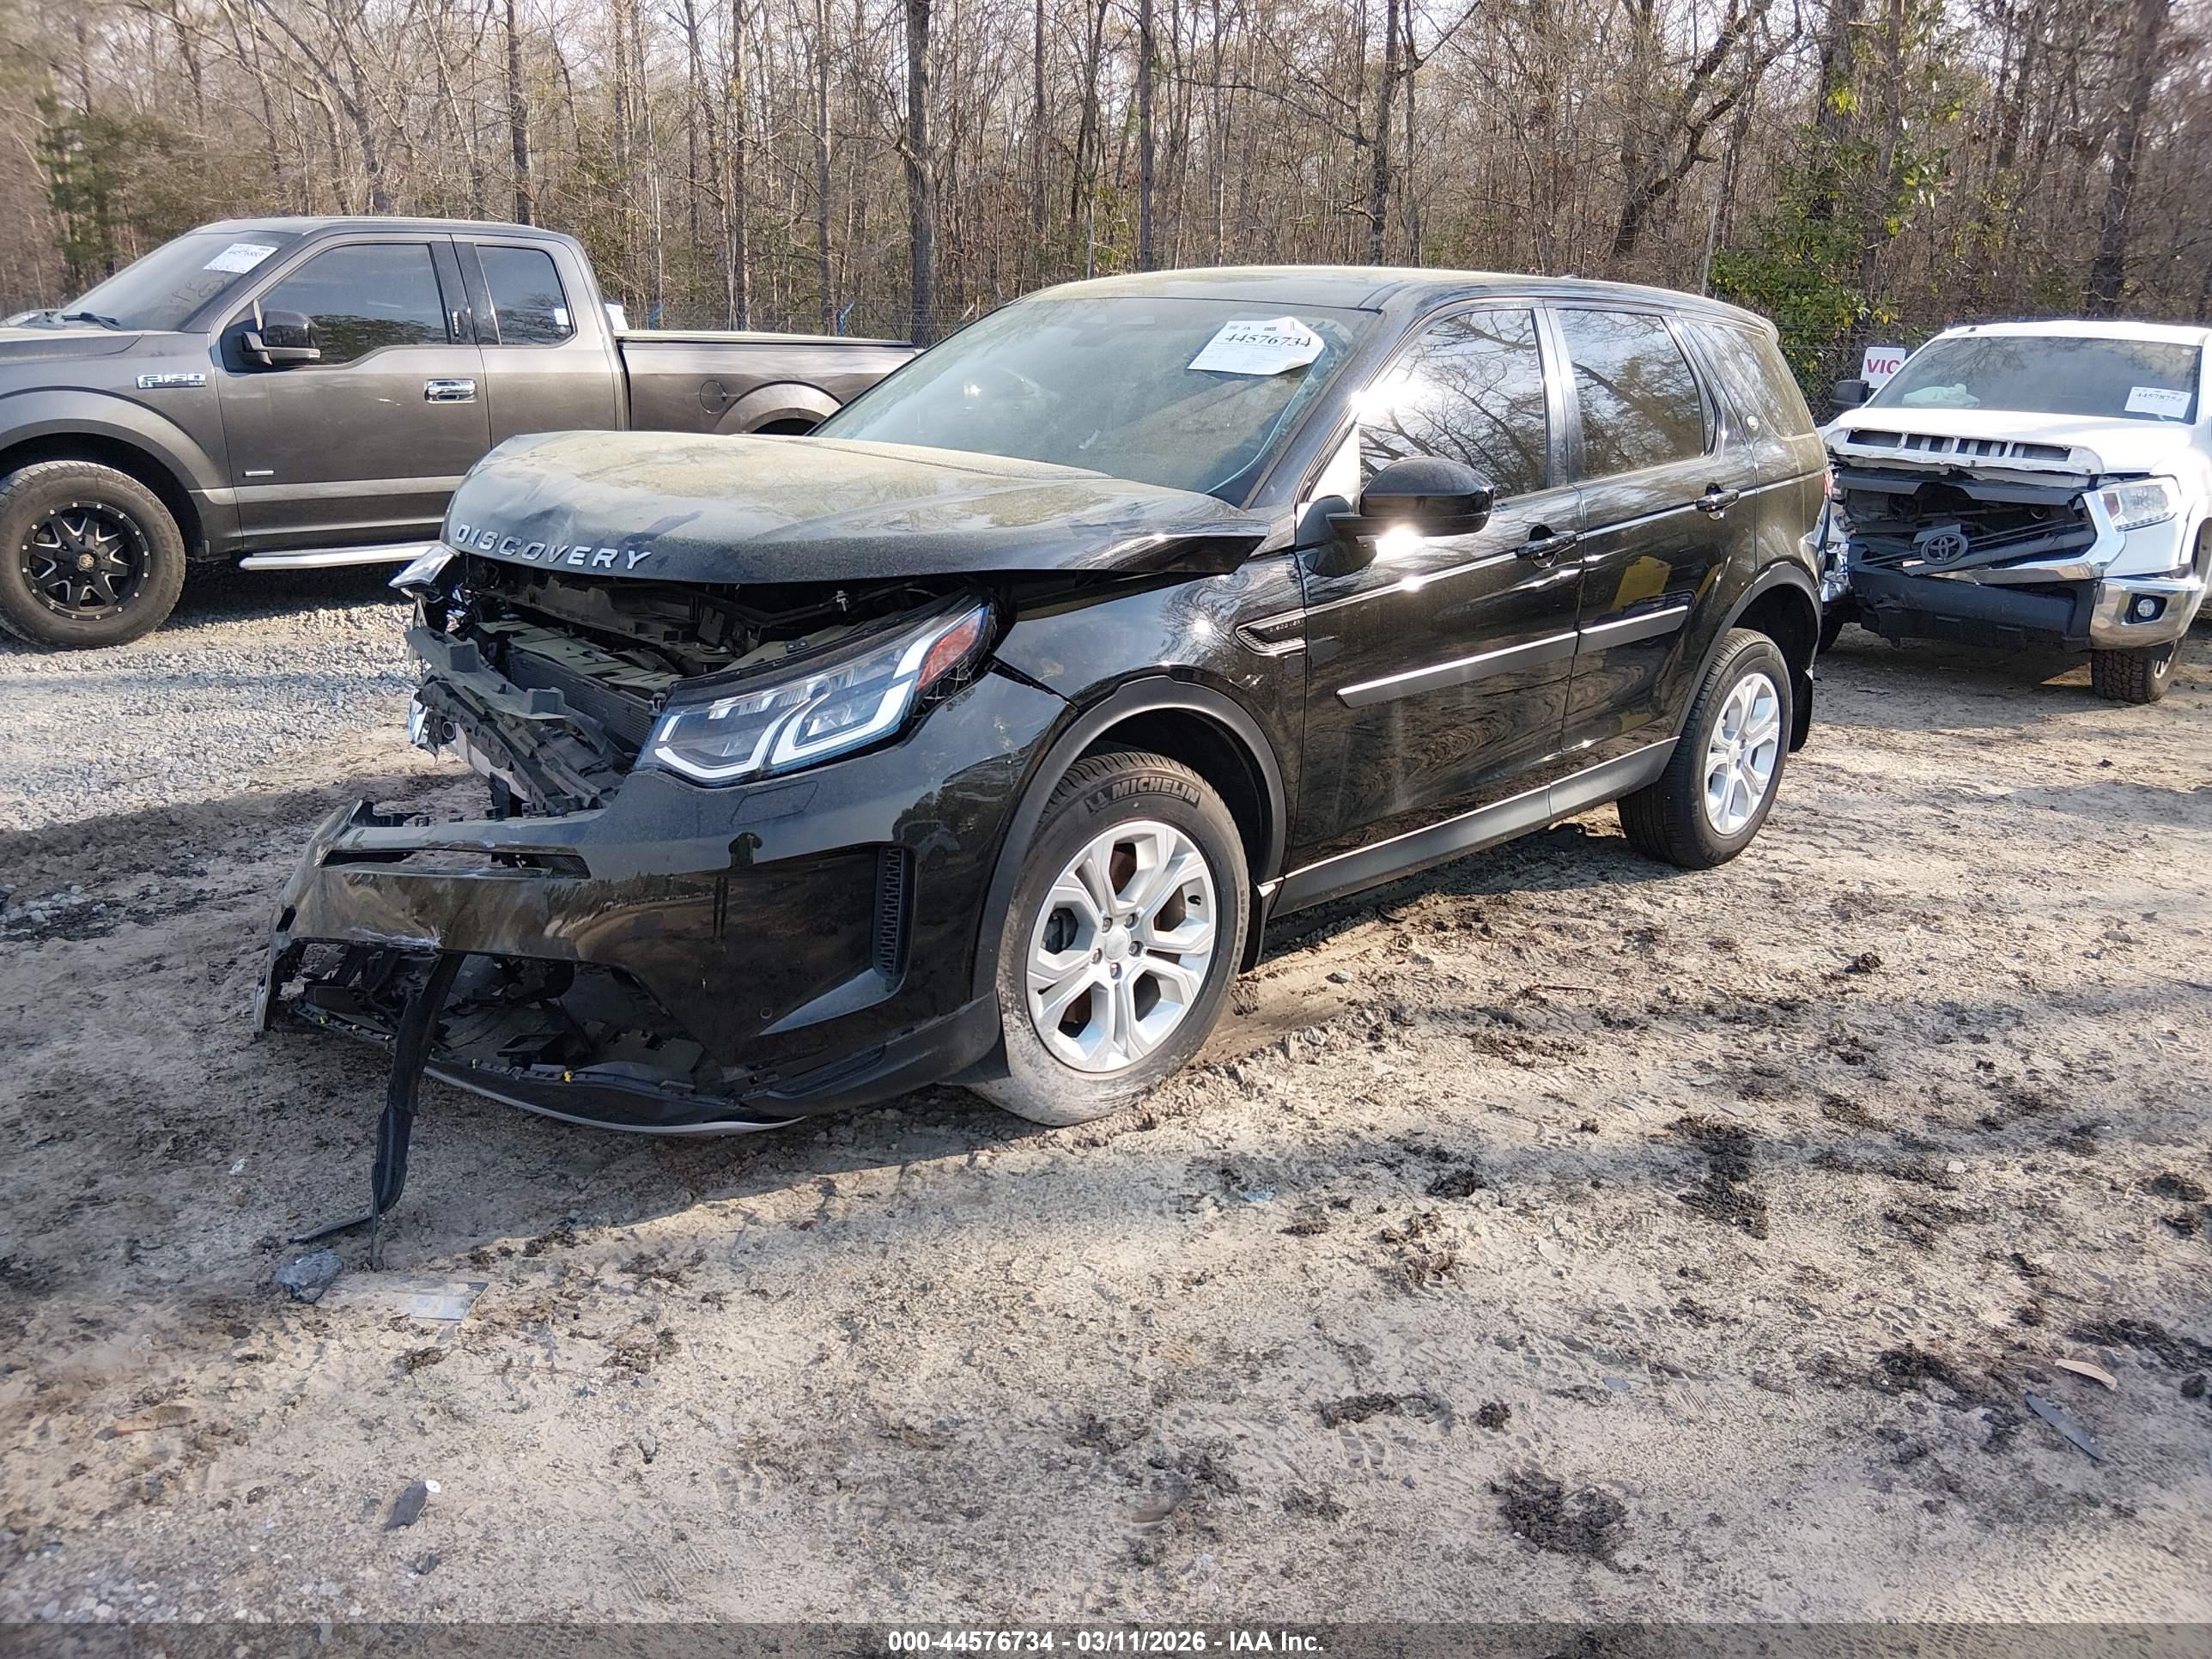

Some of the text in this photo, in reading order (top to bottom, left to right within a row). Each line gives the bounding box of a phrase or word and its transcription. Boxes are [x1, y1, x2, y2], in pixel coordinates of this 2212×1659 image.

[1224, 333, 1312, 348] 44576734
[455, 524, 652, 569] DISCOVERY
[1112, 777, 1200, 804] MICHELIN
